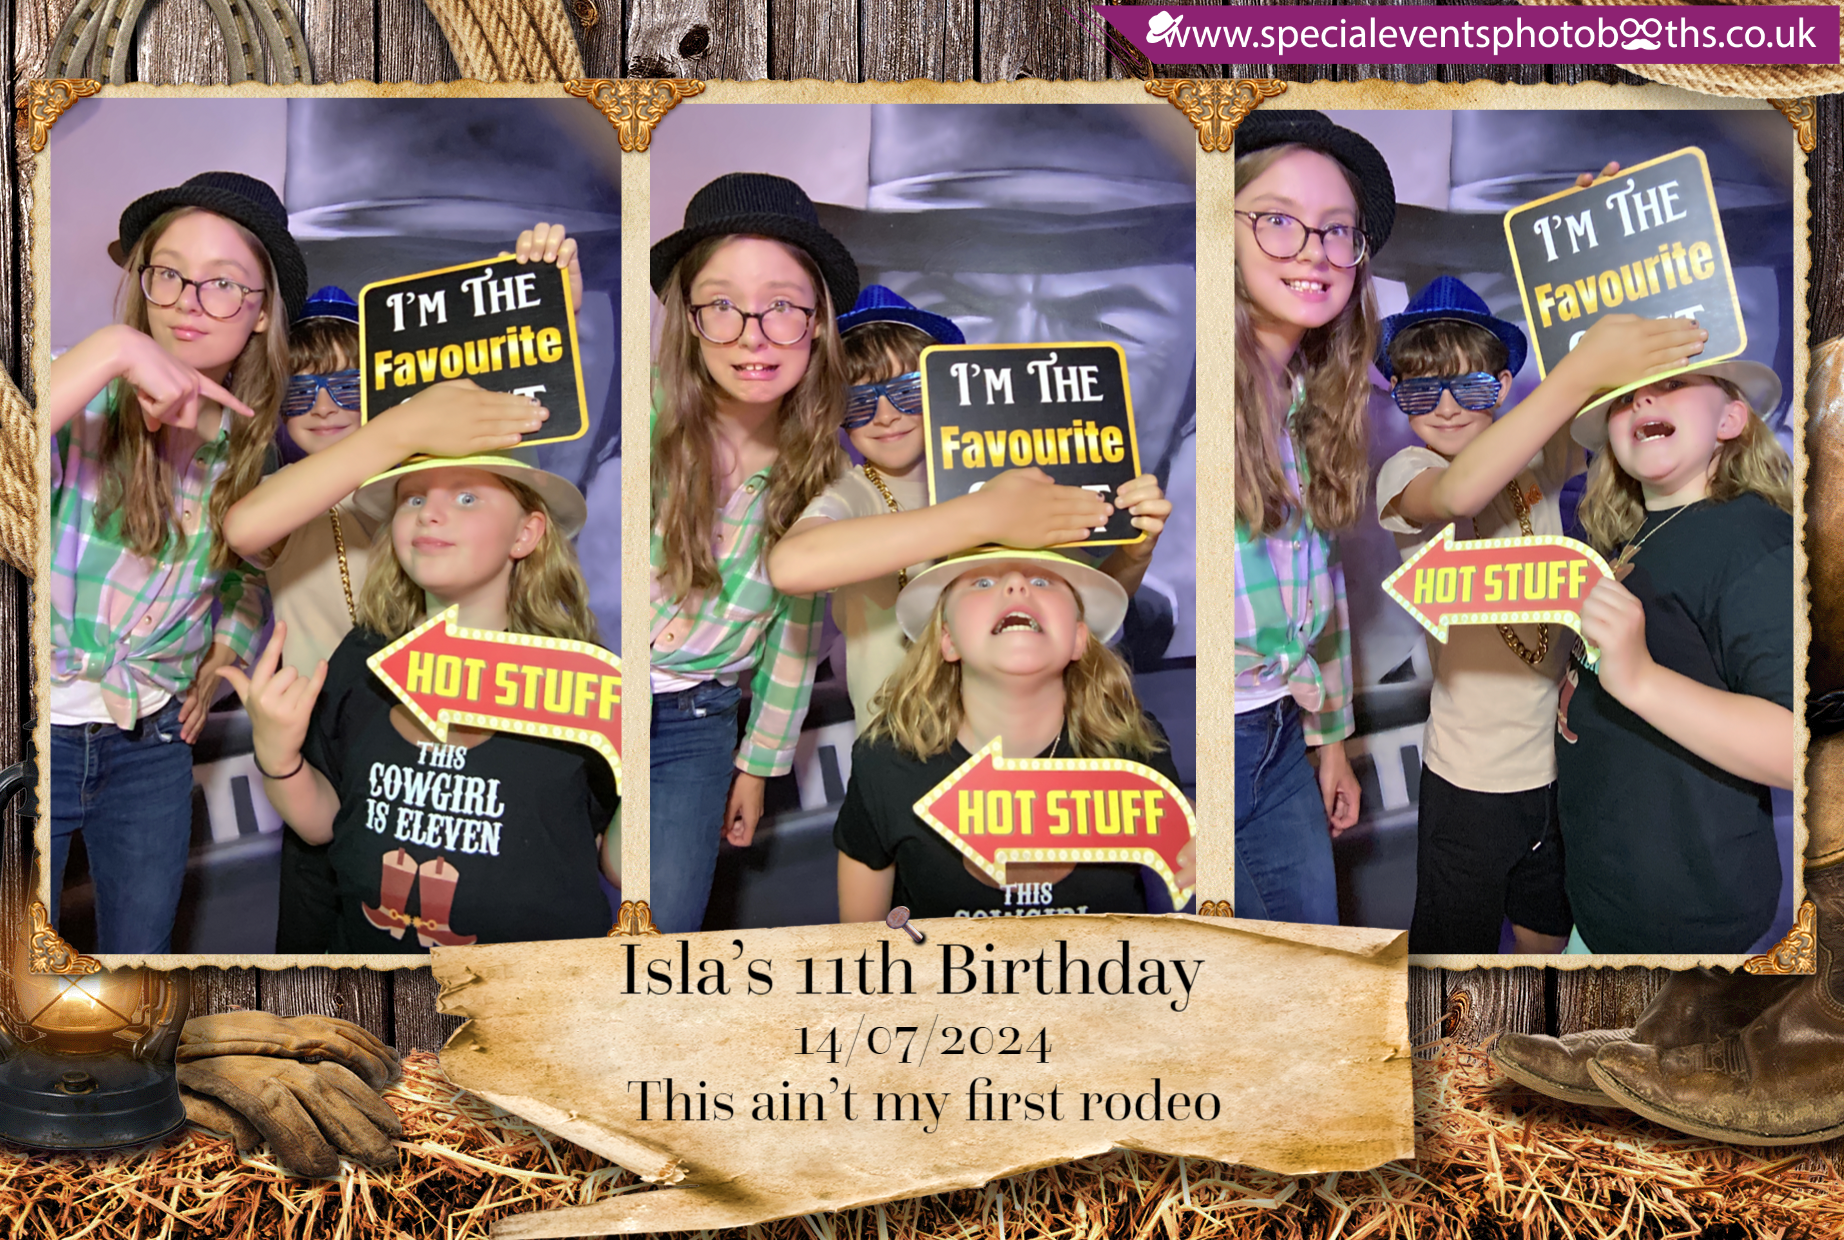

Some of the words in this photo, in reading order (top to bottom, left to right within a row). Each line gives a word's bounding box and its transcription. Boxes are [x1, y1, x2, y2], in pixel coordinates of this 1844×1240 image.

[1533, 209, 1599, 262] I'M
[1605, 178, 1688, 237] THE
[386, 290, 448, 332] I'M
[460, 267, 542, 317] THE
[1534, 240, 1715, 328] Favourite
[374, 325, 564, 391] Favourite
[950, 362, 1015, 406] I'M
[1027, 351, 1104, 404] THE
[940, 419, 1125, 470] Favourite
[1413, 566, 1477, 605] HOT
[1484, 559, 1589, 602] STUFF
[406, 650, 487, 701] HOT
[494, 661, 621, 720] STUFF
[416, 741, 467, 770] THIS
[369, 762, 505, 818] COWGIRL
[958, 789, 1038, 836] HOT
[1046, 789, 1165, 836] STUFF
[366, 798, 390, 834] IS
[394, 807, 503, 856] ELEVEN
[1000, 881, 1053, 906] THIS
